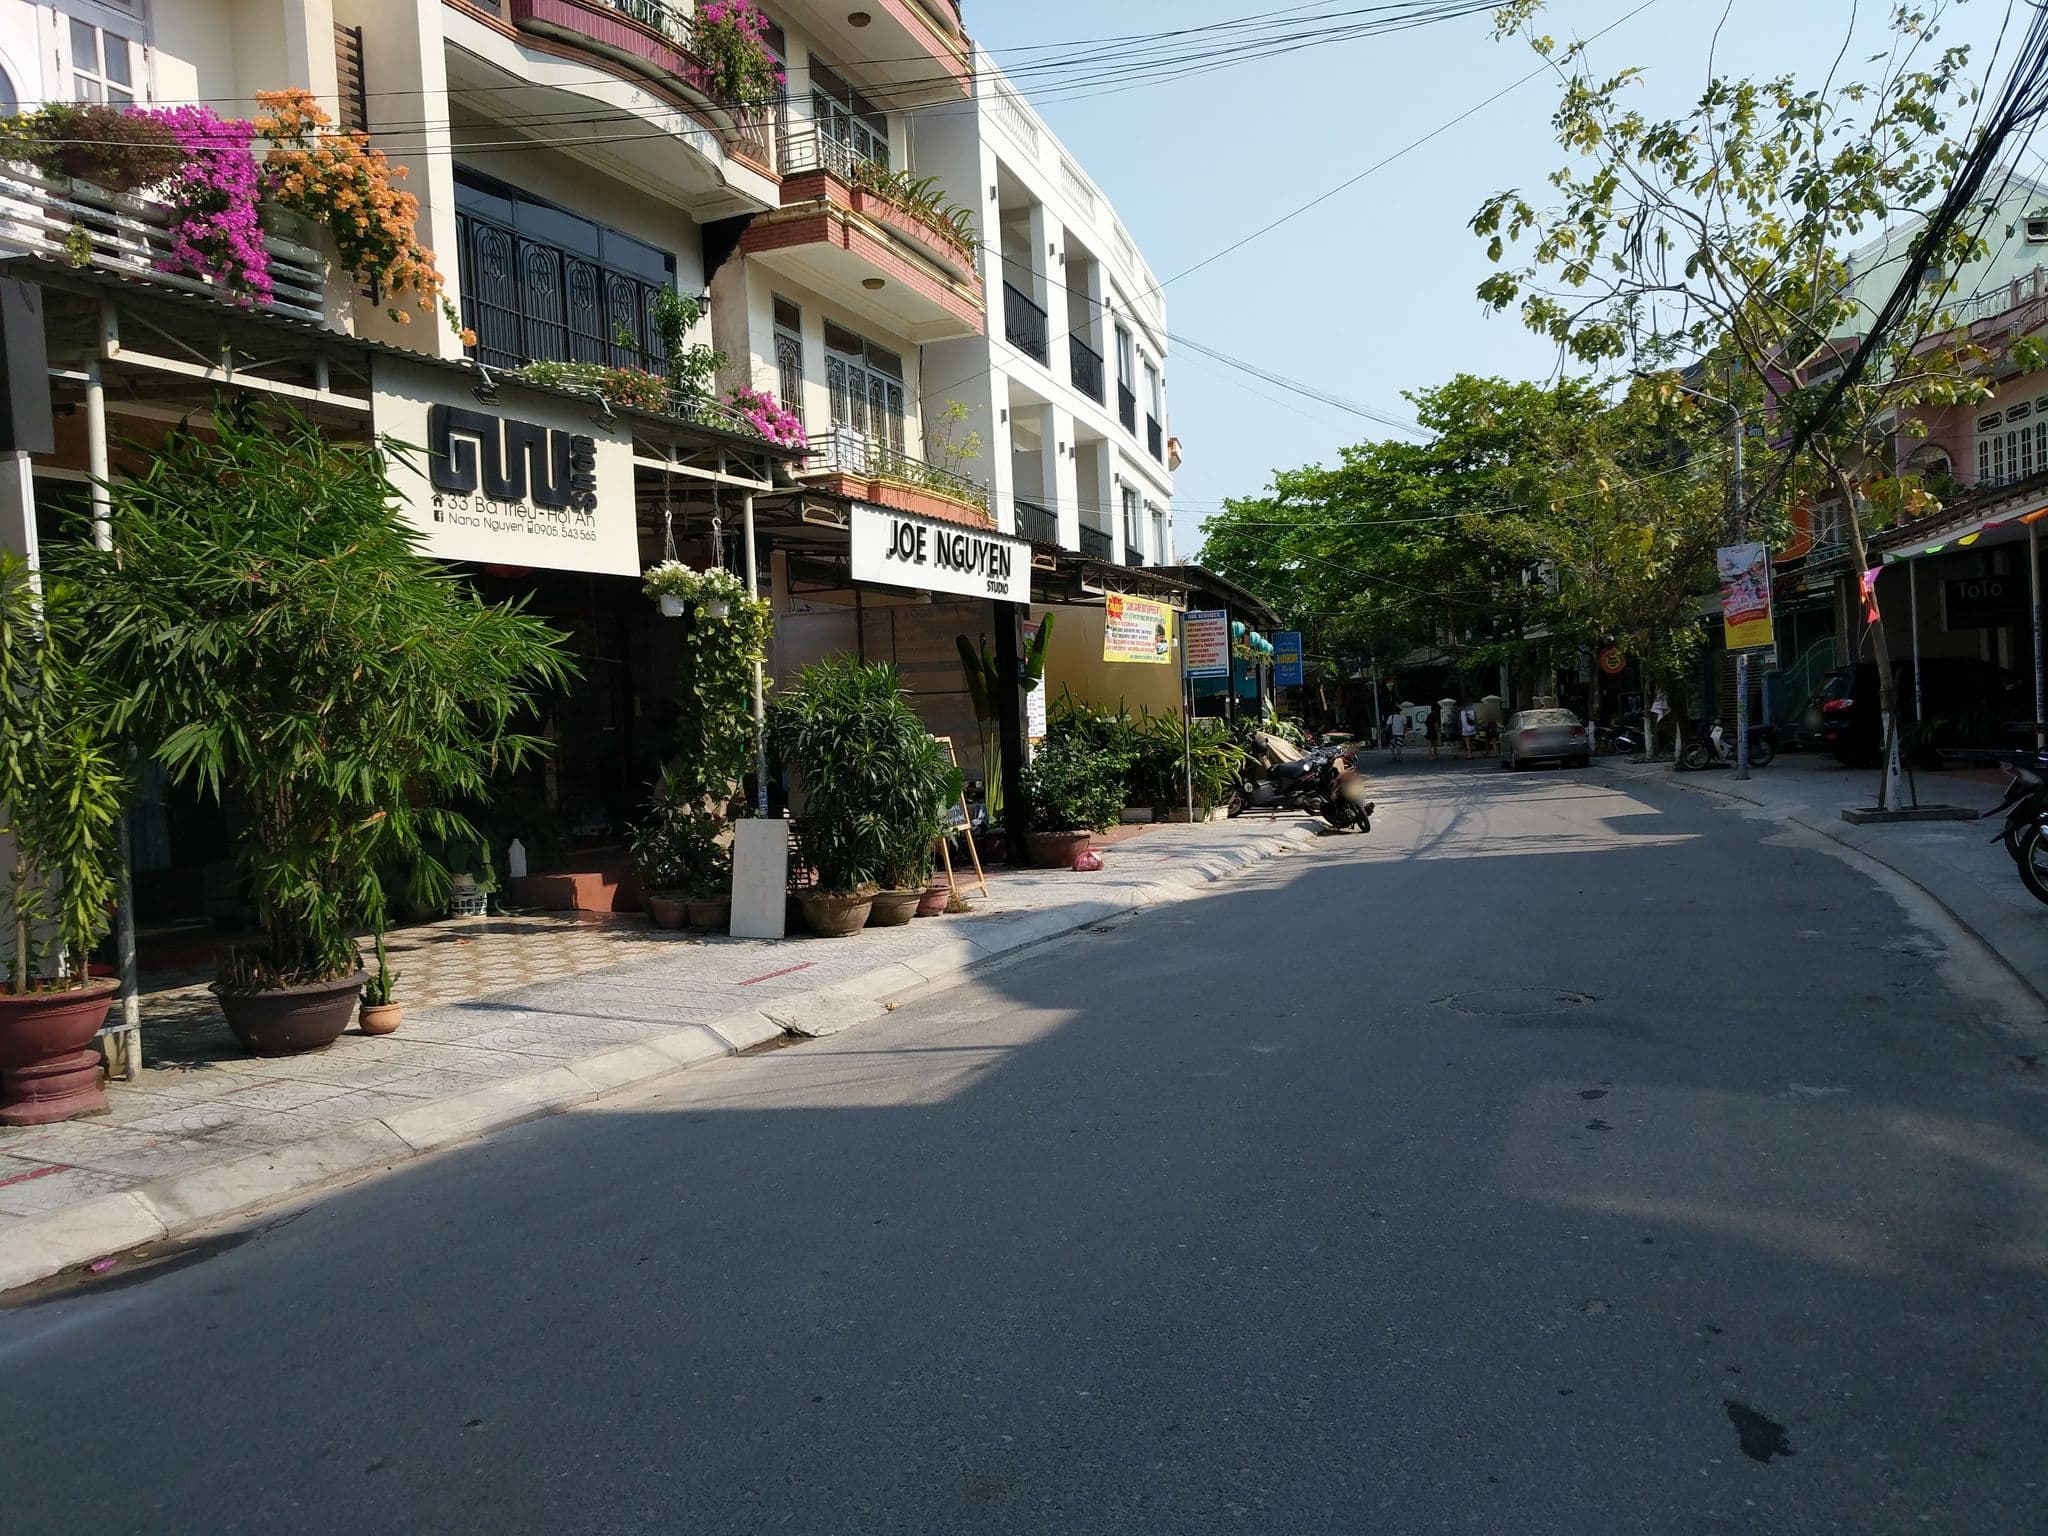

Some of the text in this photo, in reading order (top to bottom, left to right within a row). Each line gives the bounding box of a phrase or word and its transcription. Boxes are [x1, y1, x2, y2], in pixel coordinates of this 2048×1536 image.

[447, 492, 469, 511] 33
[574, 511, 596, 529] An
[448, 512, 525, 533] Nana Nguyen
[887, 518, 1012, 577] JOE NGUYEN
[986, 580, 1010, 595] STUDIO
